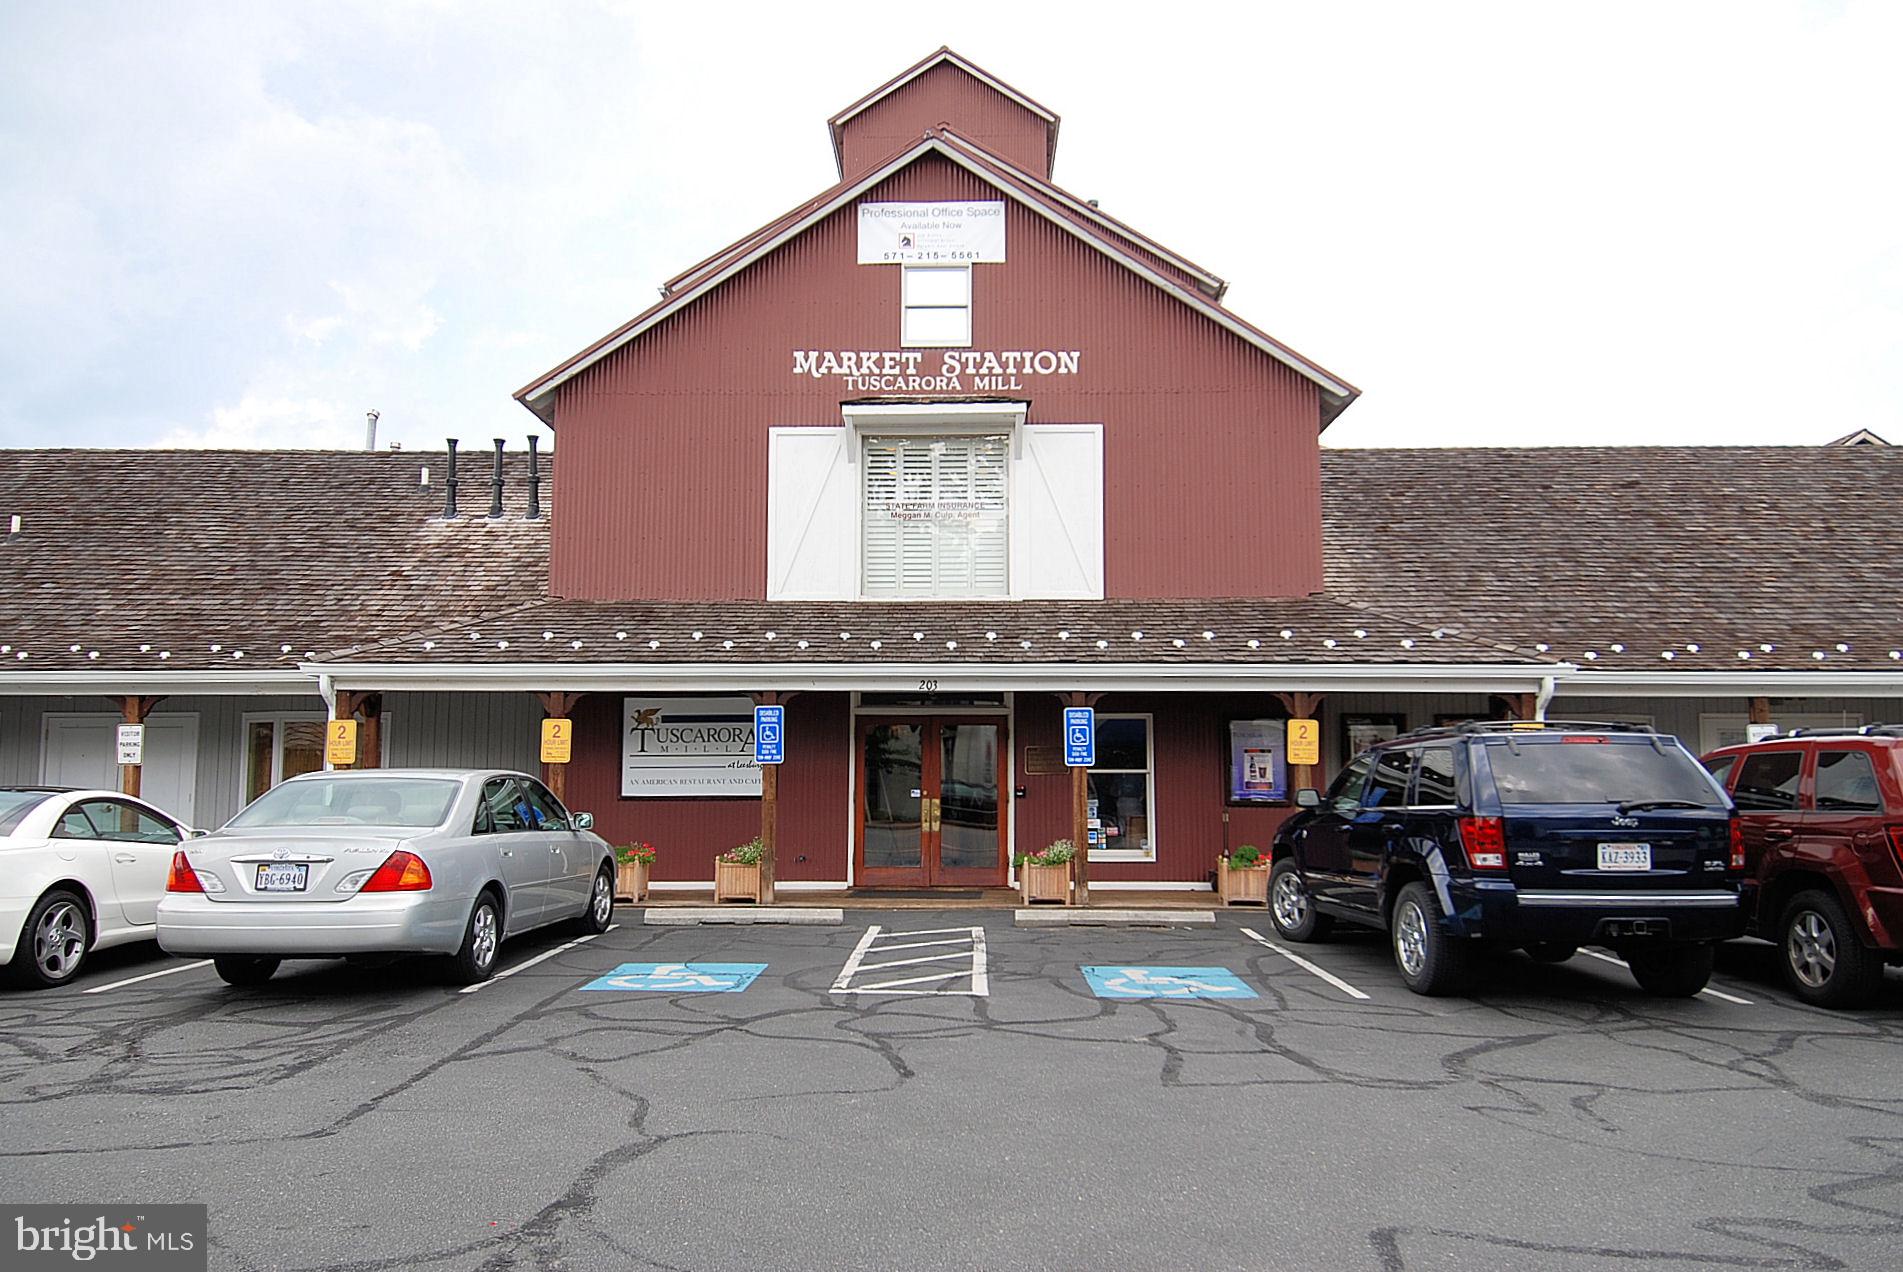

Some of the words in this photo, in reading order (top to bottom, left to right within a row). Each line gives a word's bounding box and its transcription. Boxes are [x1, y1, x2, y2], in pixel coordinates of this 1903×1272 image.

[861, 207, 929, 218] Professional
[932, 207, 964, 218] Office
[966, 207, 1001, 218] Space
[901, 222, 940, 230] Available
[942, 221, 963, 230] Now
[792, 351, 922, 378] MARKET
[941, 351, 1080, 377] STATION
[843, 375, 962, 391] TUSCARORA
[974, 375, 1023, 391] MILL
[885, 502, 909, 510] STATE
[912, 502, 935, 510] FARM
[937, 502, 985, 510] INSURANCE
[890, 511, 922, 520] Meggan
[957, 511, 980, 520] Agent
[919, 680, 938, 691] 203
[337, 725, 346, 740] 2
[552, 724, 561, 739] 2
[1299, 725, 1308, 740] 2
[727, 761, 736, 769] at
[736, 760, 763, 772] Leesburg
[630, 778, 640, 786] AN
[641, 778, 678, 786] AMERICAN
[680, 778, 726, 786] RESTAURANT
[1611, 816, 1639, 828] Jeep
